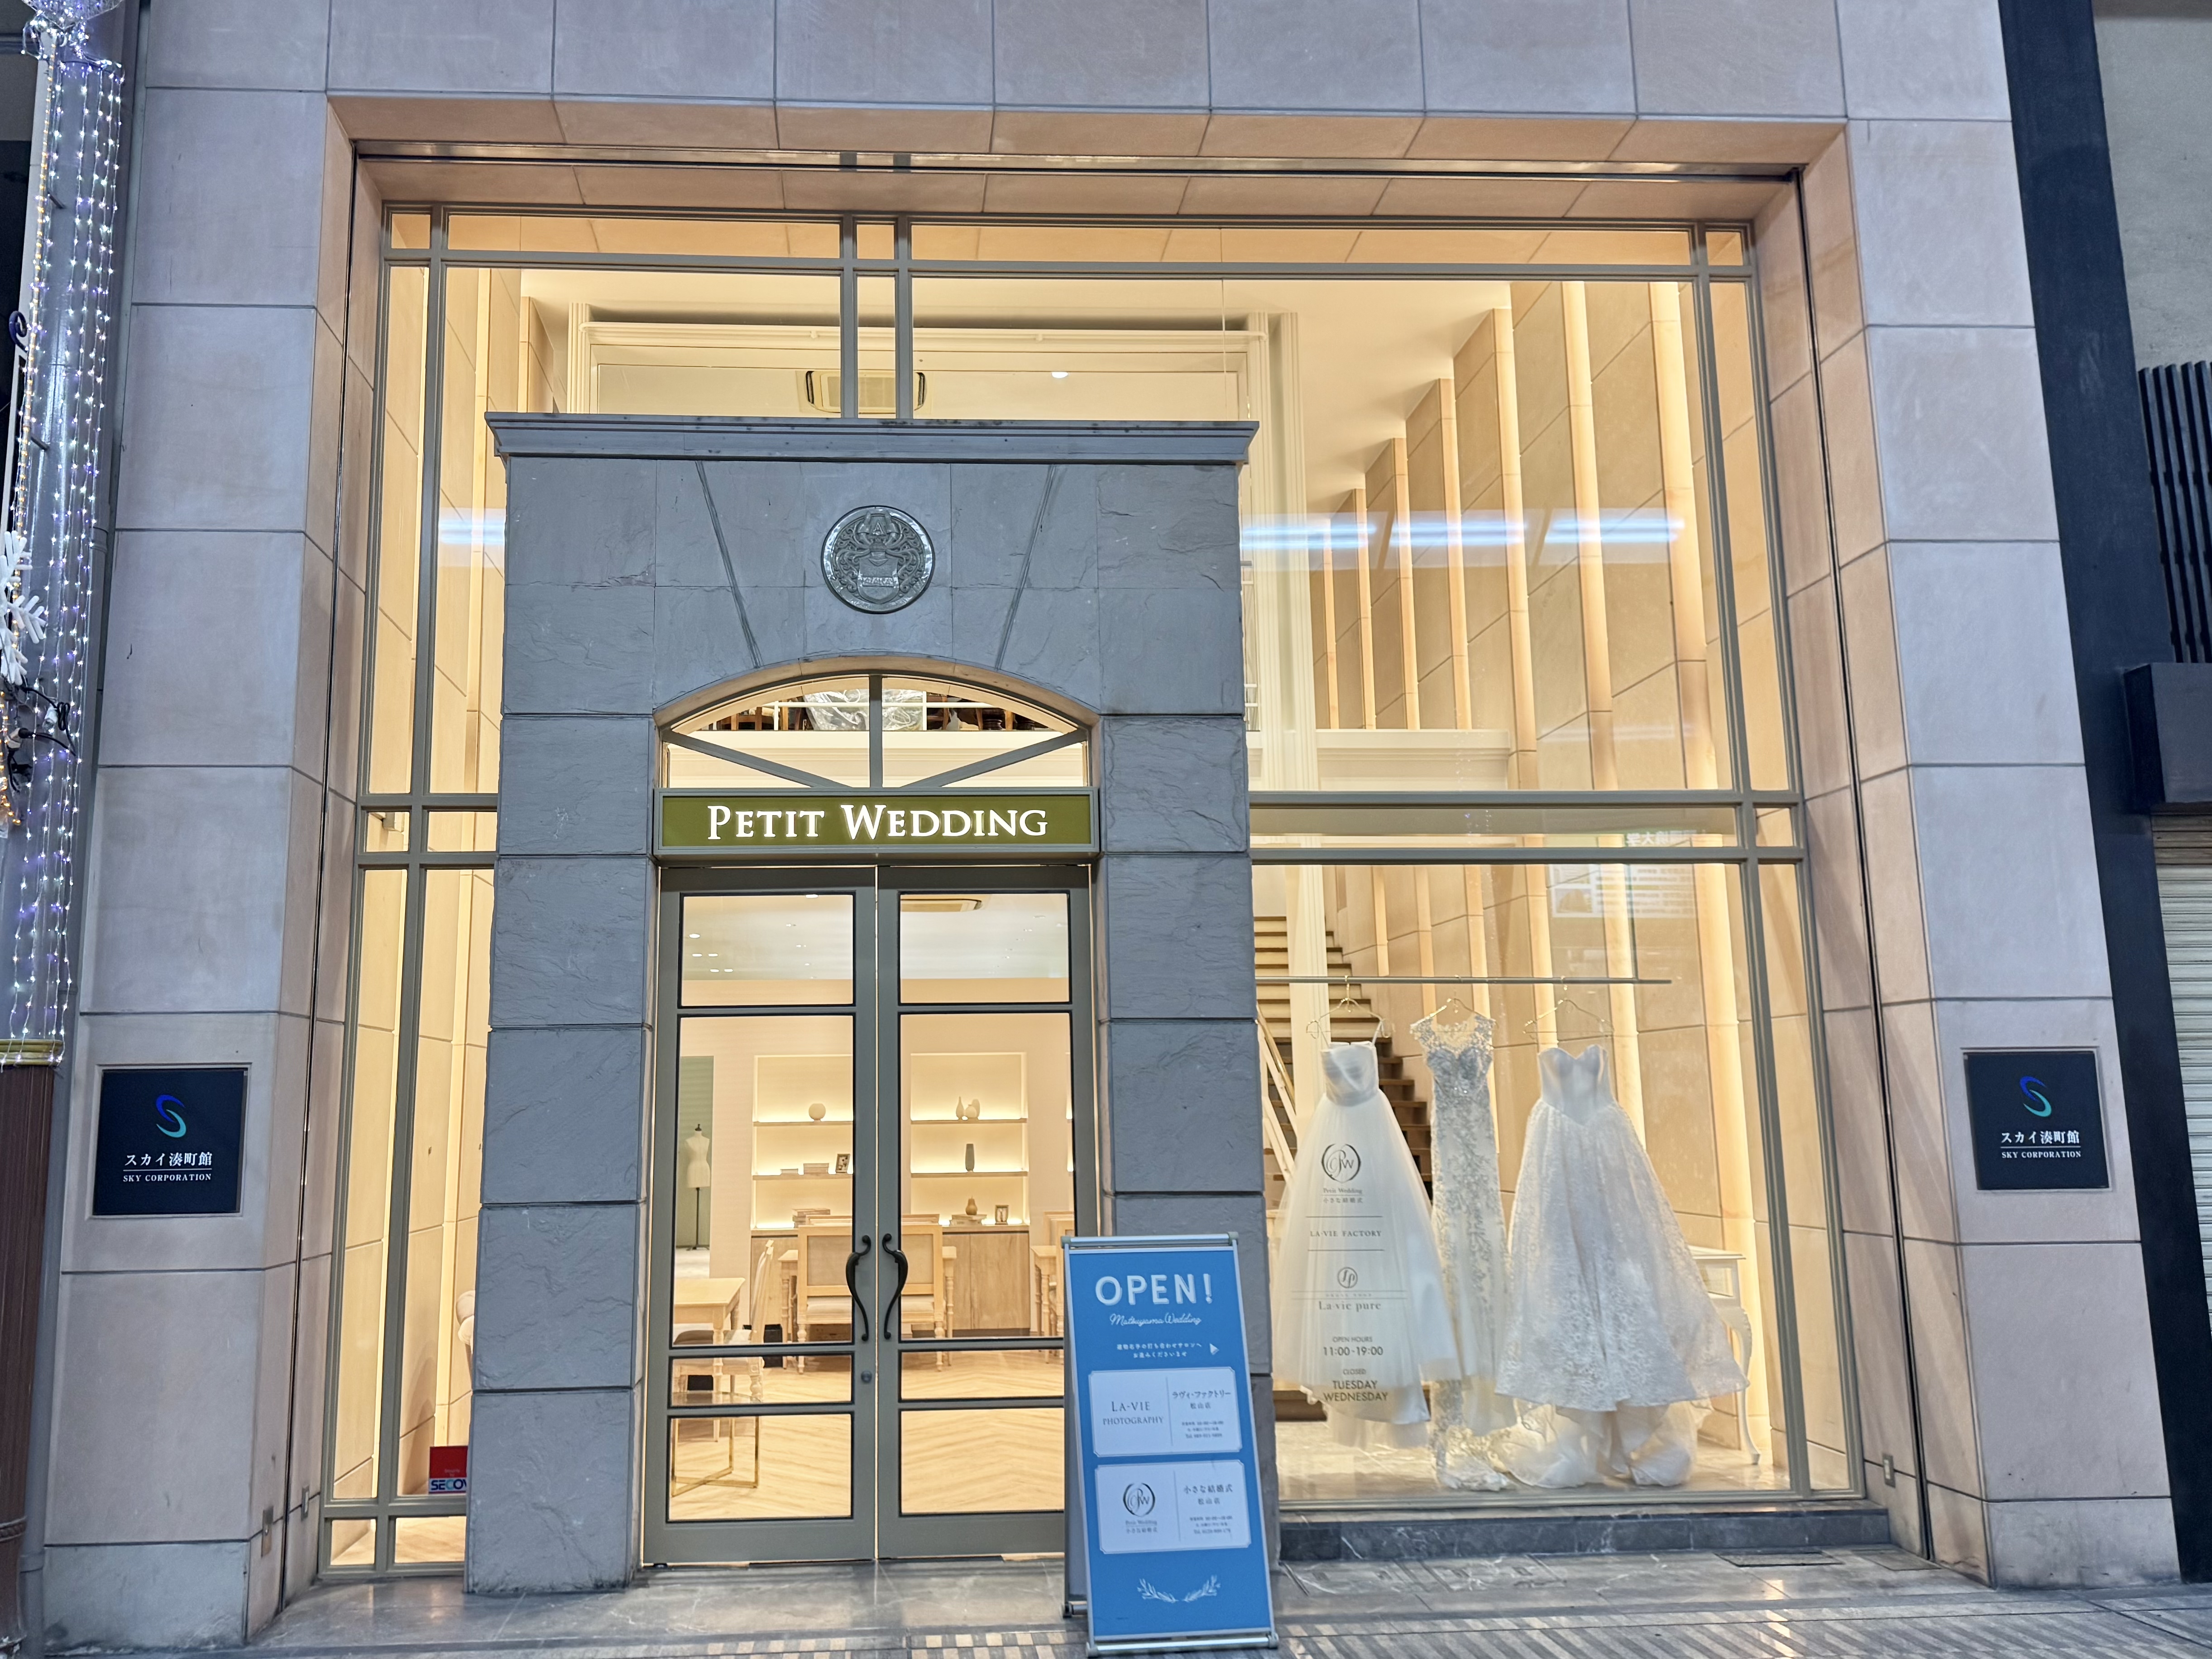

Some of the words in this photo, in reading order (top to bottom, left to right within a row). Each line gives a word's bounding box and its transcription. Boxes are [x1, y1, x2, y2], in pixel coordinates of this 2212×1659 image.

[707, 805, 825, 840] PETIT
[840, 804, 1048, 840] WEDDING
[2001, 1130, 2080, 1144] スカイ湊町館
[124, 1151, 212, 1166] スカイ湊町館
[145, 1173, 211, 1182] CORPORATION
[1095, 1273, 1212, 1306] OPEN!
[1355, 1303, 1381, 1313] pure
[1164, 1312, 1202, 1325] Wedding
[1332, 1380, 1378, 1390] TUESDAY
[1323, 1391, 1388, 1402] WEDNESDAY
[1102, 1416, 1163, 1425] PHOTOGRAPHY
